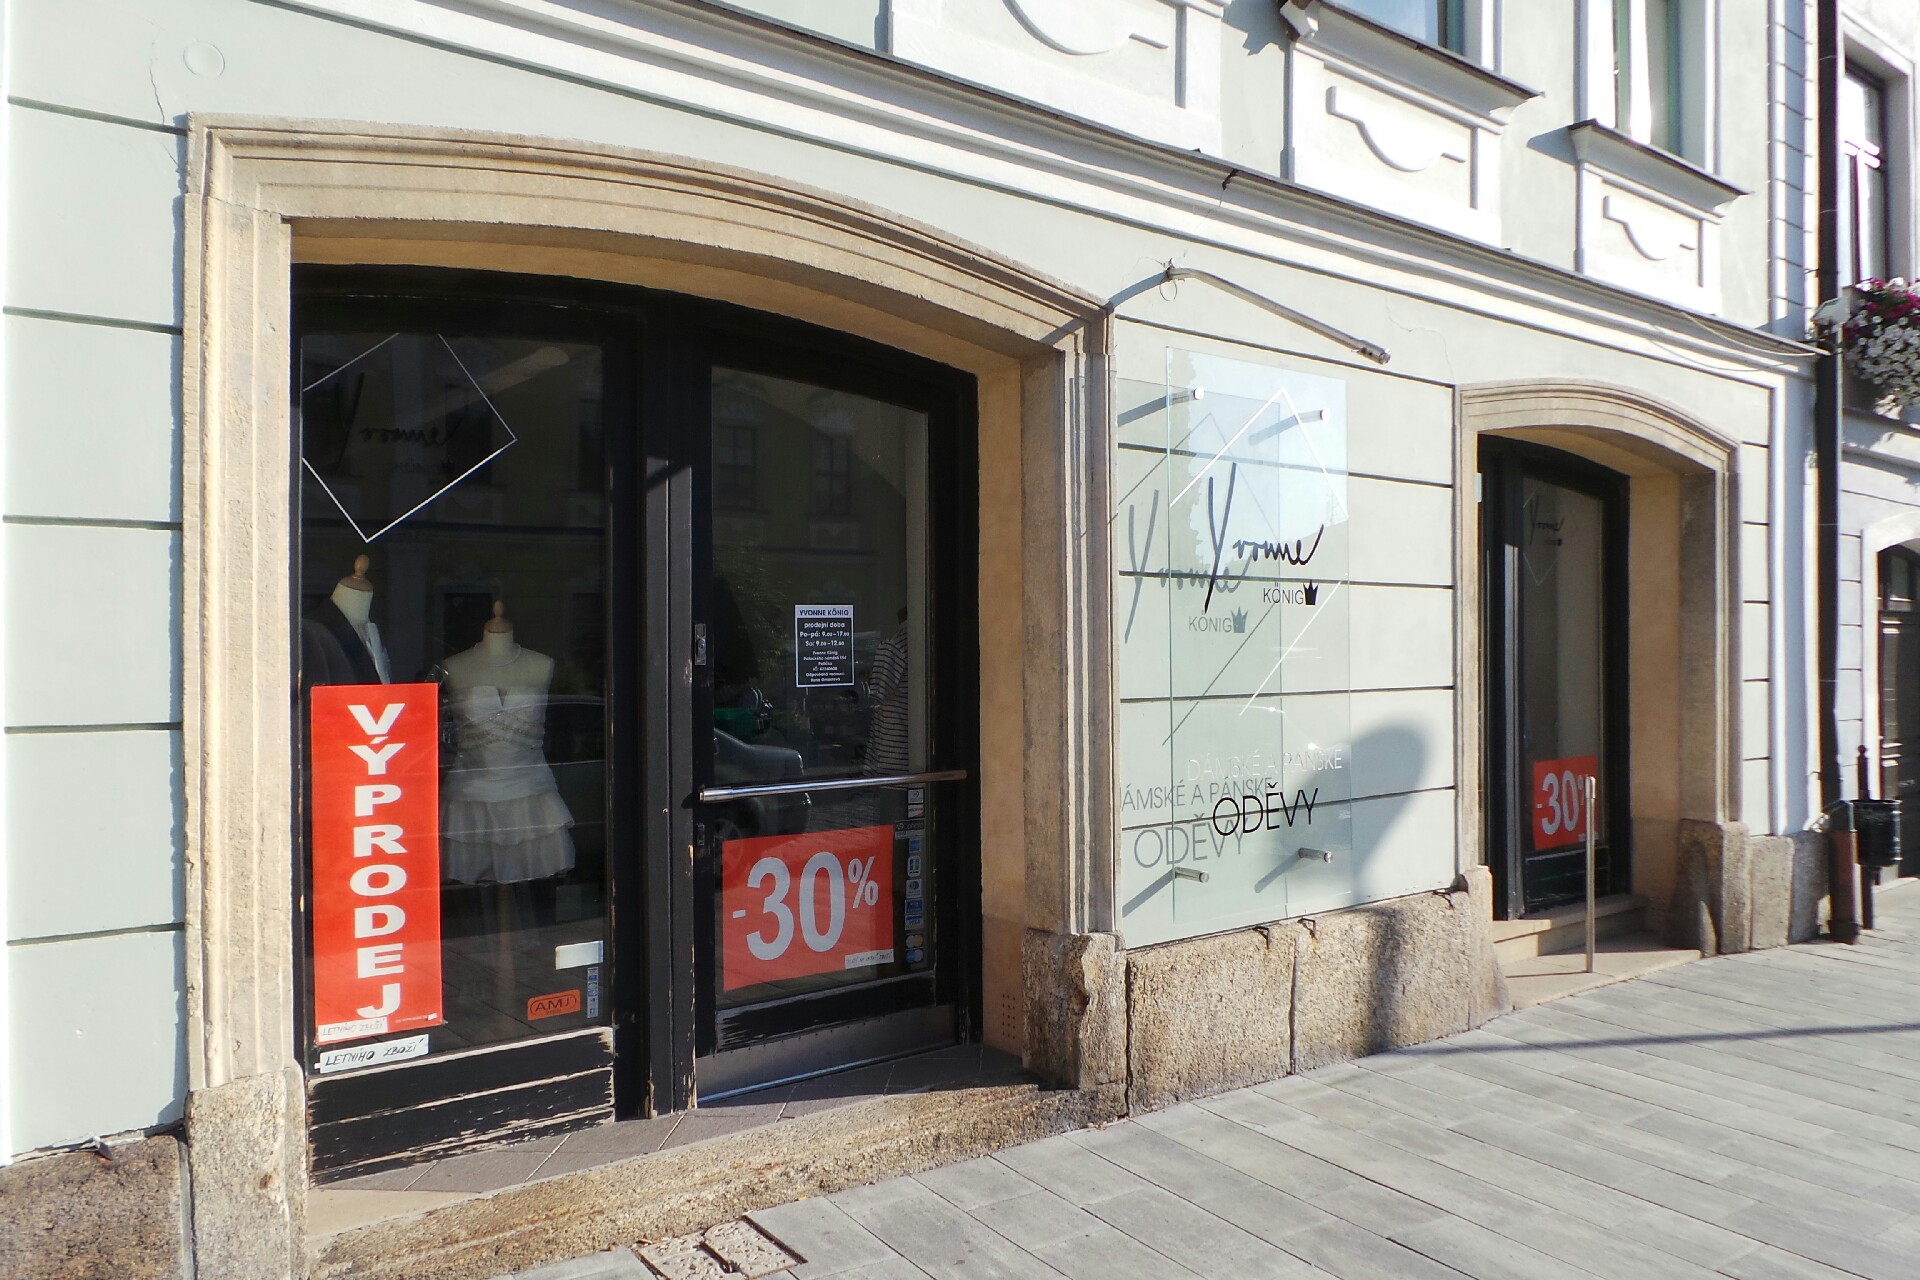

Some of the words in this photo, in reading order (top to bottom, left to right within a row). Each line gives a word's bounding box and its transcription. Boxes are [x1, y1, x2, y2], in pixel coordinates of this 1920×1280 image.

[827, 608, 849, 616] KÖNIG
[1263, 582, 1304, 605] KÖNIG
[1212, 781, 1319, 837] ODĚVY
[346, 702, 409, 1020] VÝPRODEJ
[732, 851, 879, 961] -30%
